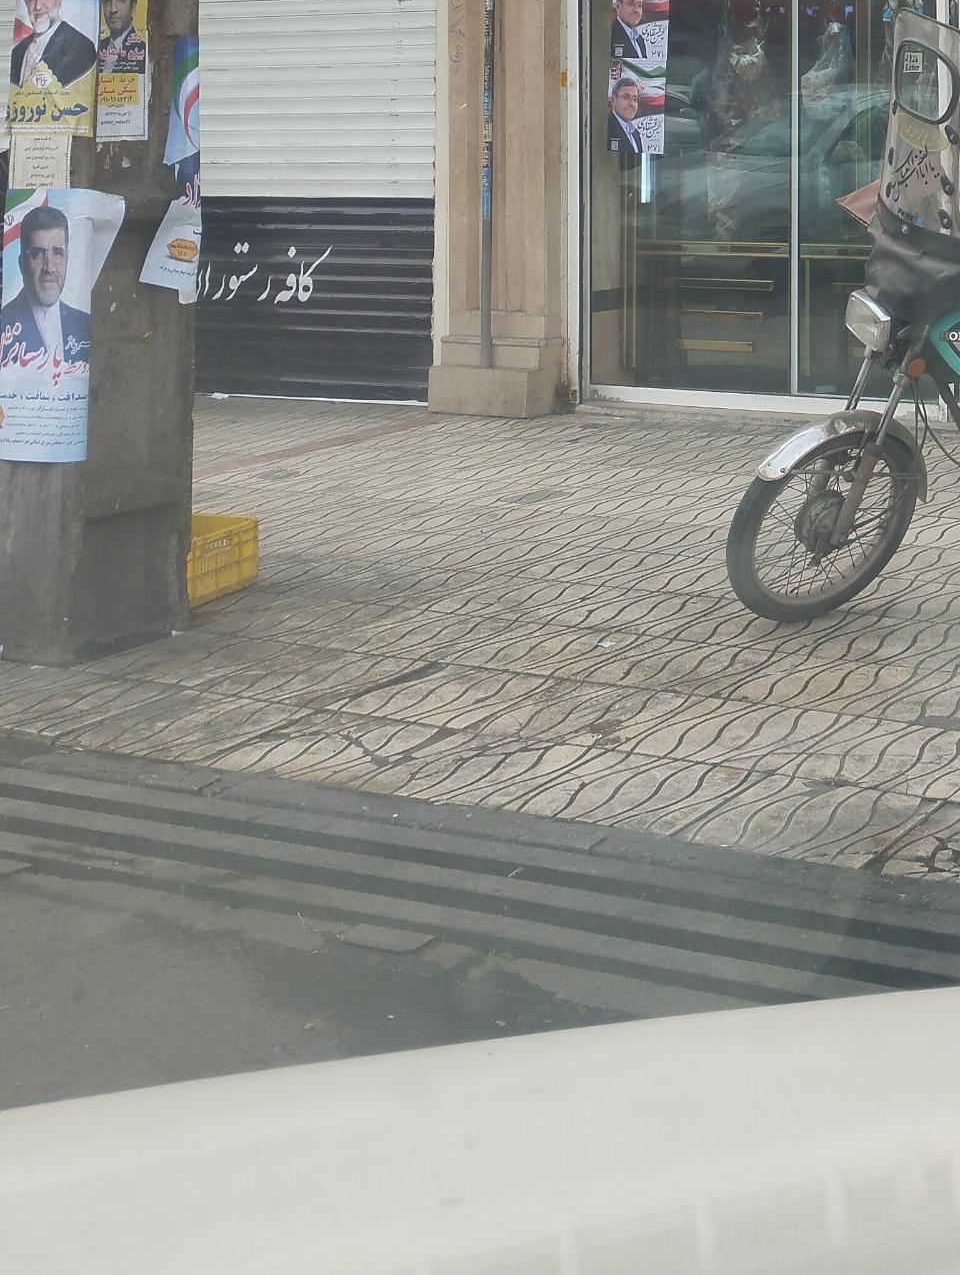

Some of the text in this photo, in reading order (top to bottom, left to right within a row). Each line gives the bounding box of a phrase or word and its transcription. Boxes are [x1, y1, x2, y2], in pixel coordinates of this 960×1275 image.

[651, 50, 664, 58] ۲۷۱
[51, 103, 89, 122] حسن
[647, 144, 661, 153] ۲۷۱
[274, 245, 333, 304] کافه
[0, 391, 17, 401] خدم
